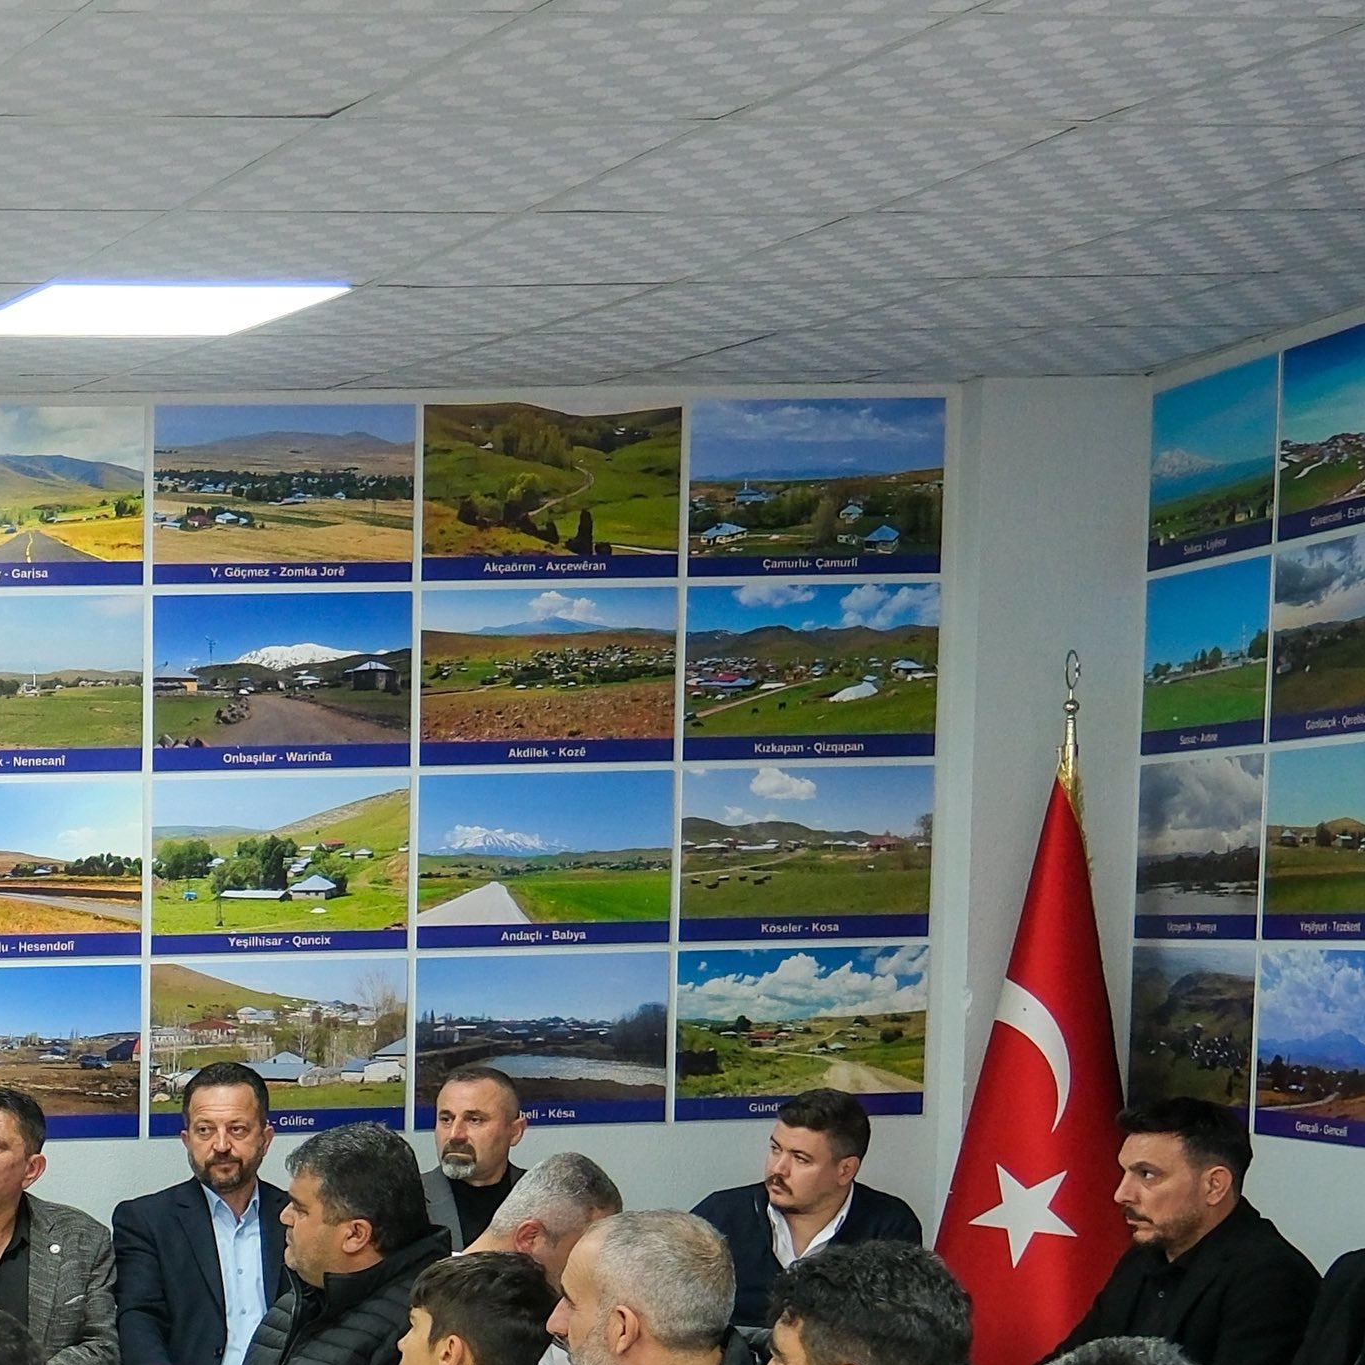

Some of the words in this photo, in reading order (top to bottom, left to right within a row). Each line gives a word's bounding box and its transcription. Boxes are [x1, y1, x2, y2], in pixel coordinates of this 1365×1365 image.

[211, 567, 221, 577] Y.
[225, 568, 269, 579] Göçmez
[280, 567, 317, 576] Zomka
[321, 566, 344, 576] Jorê
[484, 563, 535, 574] Akçaören
[509, 748, 548, 757] Akdilek
[559, 747, 585, 756] Kozê
[755, 743, 803, 754] Kızkapan
[814, 743, 863, 753] Qizqapan
[223, 752, 276, 765] Onbaşılar
[228, 937, 282, 948] Yeşilhisar
[293, 935, 330, 947] Qancix
[501, 931, 542, 942] Andaçlı
